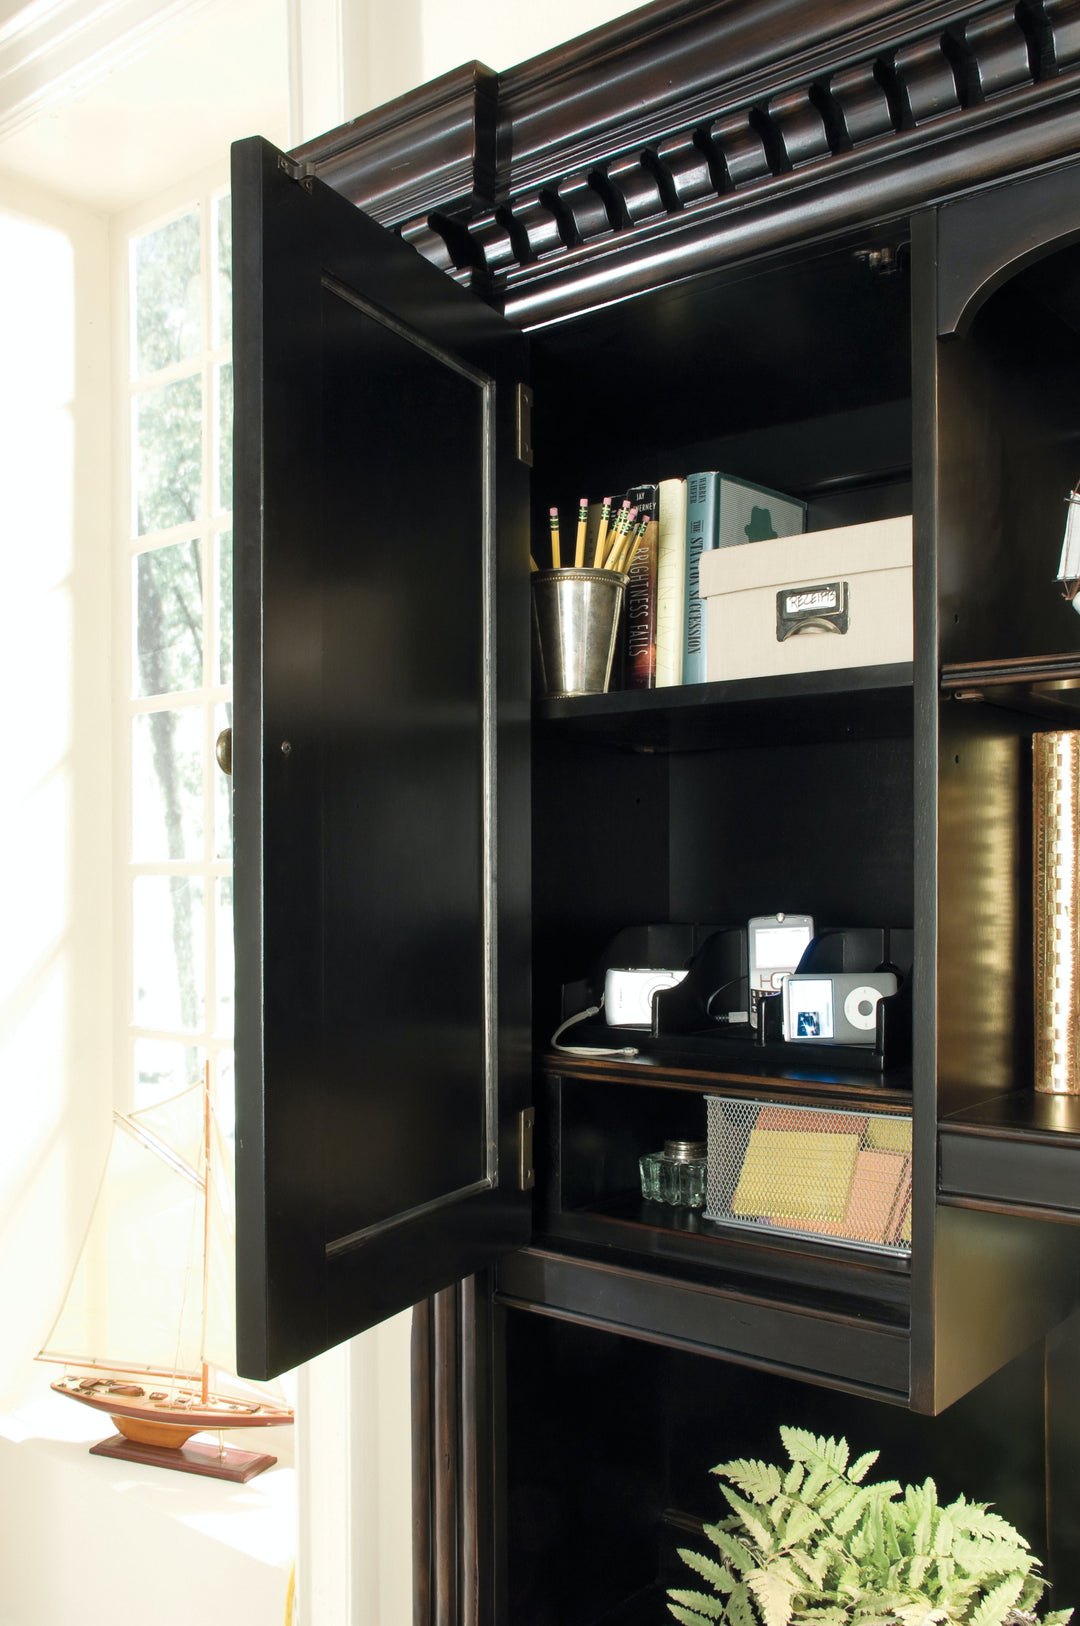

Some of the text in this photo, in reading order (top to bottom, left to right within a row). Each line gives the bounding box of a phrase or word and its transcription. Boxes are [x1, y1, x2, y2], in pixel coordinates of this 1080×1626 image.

[636, 492, 645, 501] JAY
[687, 520, 704, 655] THE STANTON SUCCESSION
[628, 624, 649, 657] FALLS
